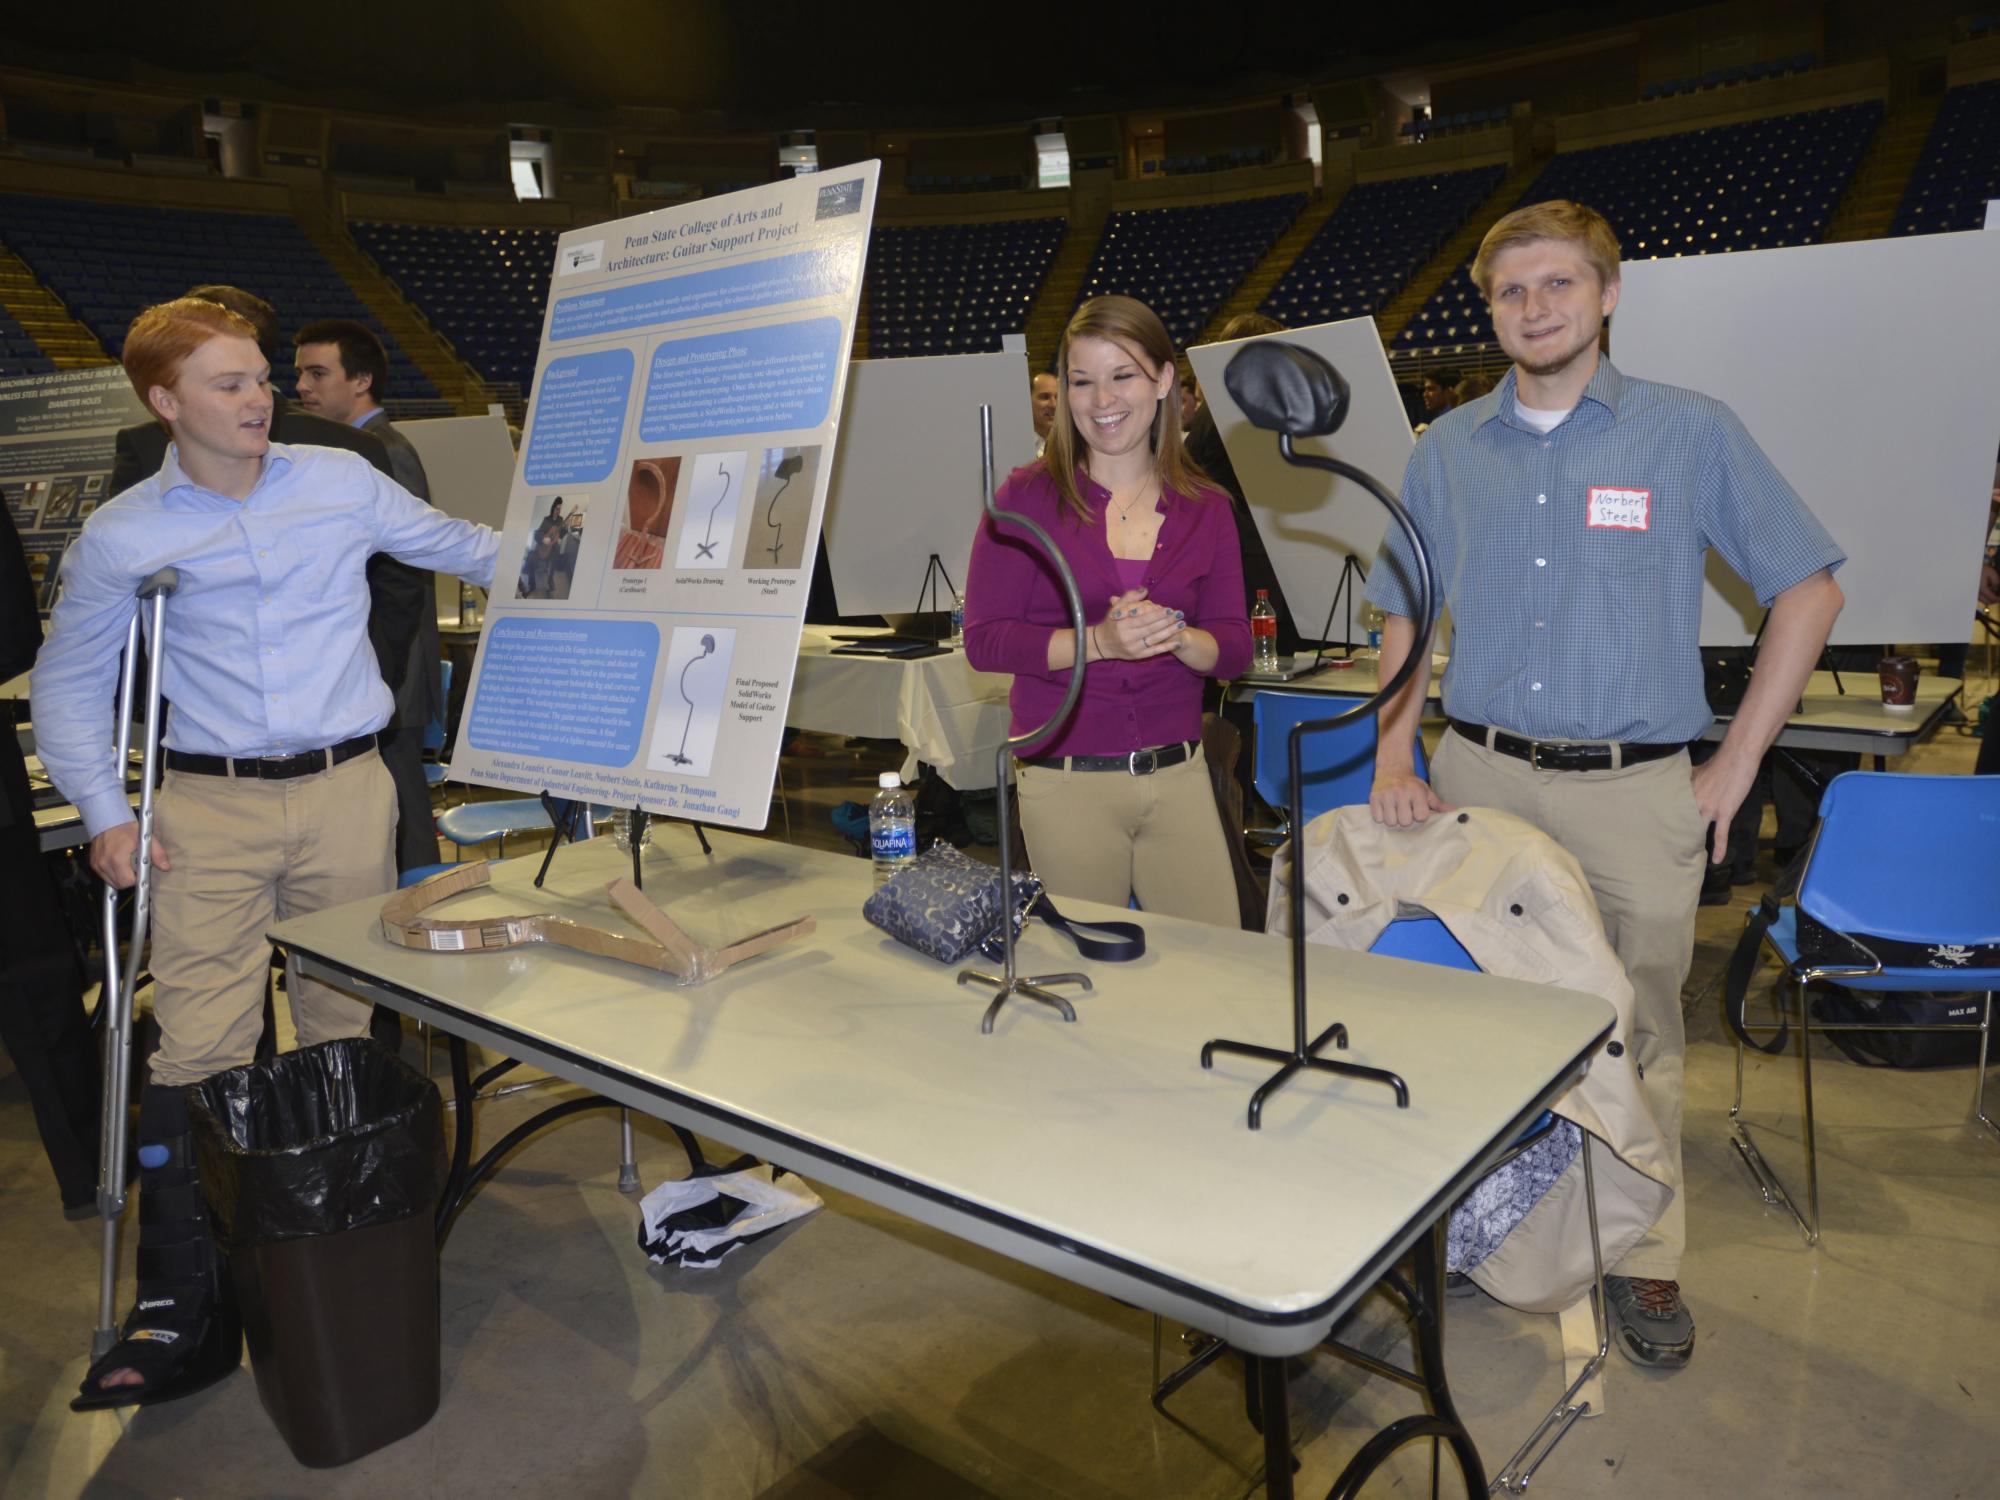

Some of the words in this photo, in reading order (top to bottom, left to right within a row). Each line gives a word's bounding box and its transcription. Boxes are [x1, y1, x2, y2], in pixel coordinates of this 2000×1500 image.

[624, 235, 648, 249] Penn
[651, 229, 677, 244] State
[680, 219, 718, 237] College
[720, 213, 733, 227] of
[732, 210, 758, 226] Arts
[760, 203, 783, 219] and
[605, 250, 669, 273] Architecture:
[673, 241, 708, 259] Guitar
[709, 232, 754, 252] Support
[757, 222, 800, 242] Project
[1595, 493, 1648, 509] Norbert
[1600, 507, 1641, 524] Steele
[702, 577, 724, 586] Drawing
[747, 577, 769, 586] Working
[770, 577, 796, 586] Prototype
[736, 678, 751, 687] Final
[752, 679, 779, 689] Proposed
[738, 689, 772, 699] SolidWorks
[730, 700, 748, 710] Model
[749, 702, 756, 710] of
[756, 702, 776, 711] Guitar
[738, 713, 763, 723] Support
[595, 771, 620, 784] Norbert
[643, 779, 678, 792] Katharine
[680, 784, 717, 798] Thompson
[470, 767, 484, 778] Penn
[485, 769, 499, 780] State
[500, 772, 534, 786] Department
[541, 779, 571, 791] Industrial
[611, 788, 636, 801] Project
[636, 791, 667, 805] Sponsor:
[668, 797, 679, 808] Dr.
[682, 800, 715, 813] Jonathan
[717, 803, 741, 819] Gangi
[872, 837, 908, 850] AQUAFINA
[1948, 1008, 1965, 1017] MAX
